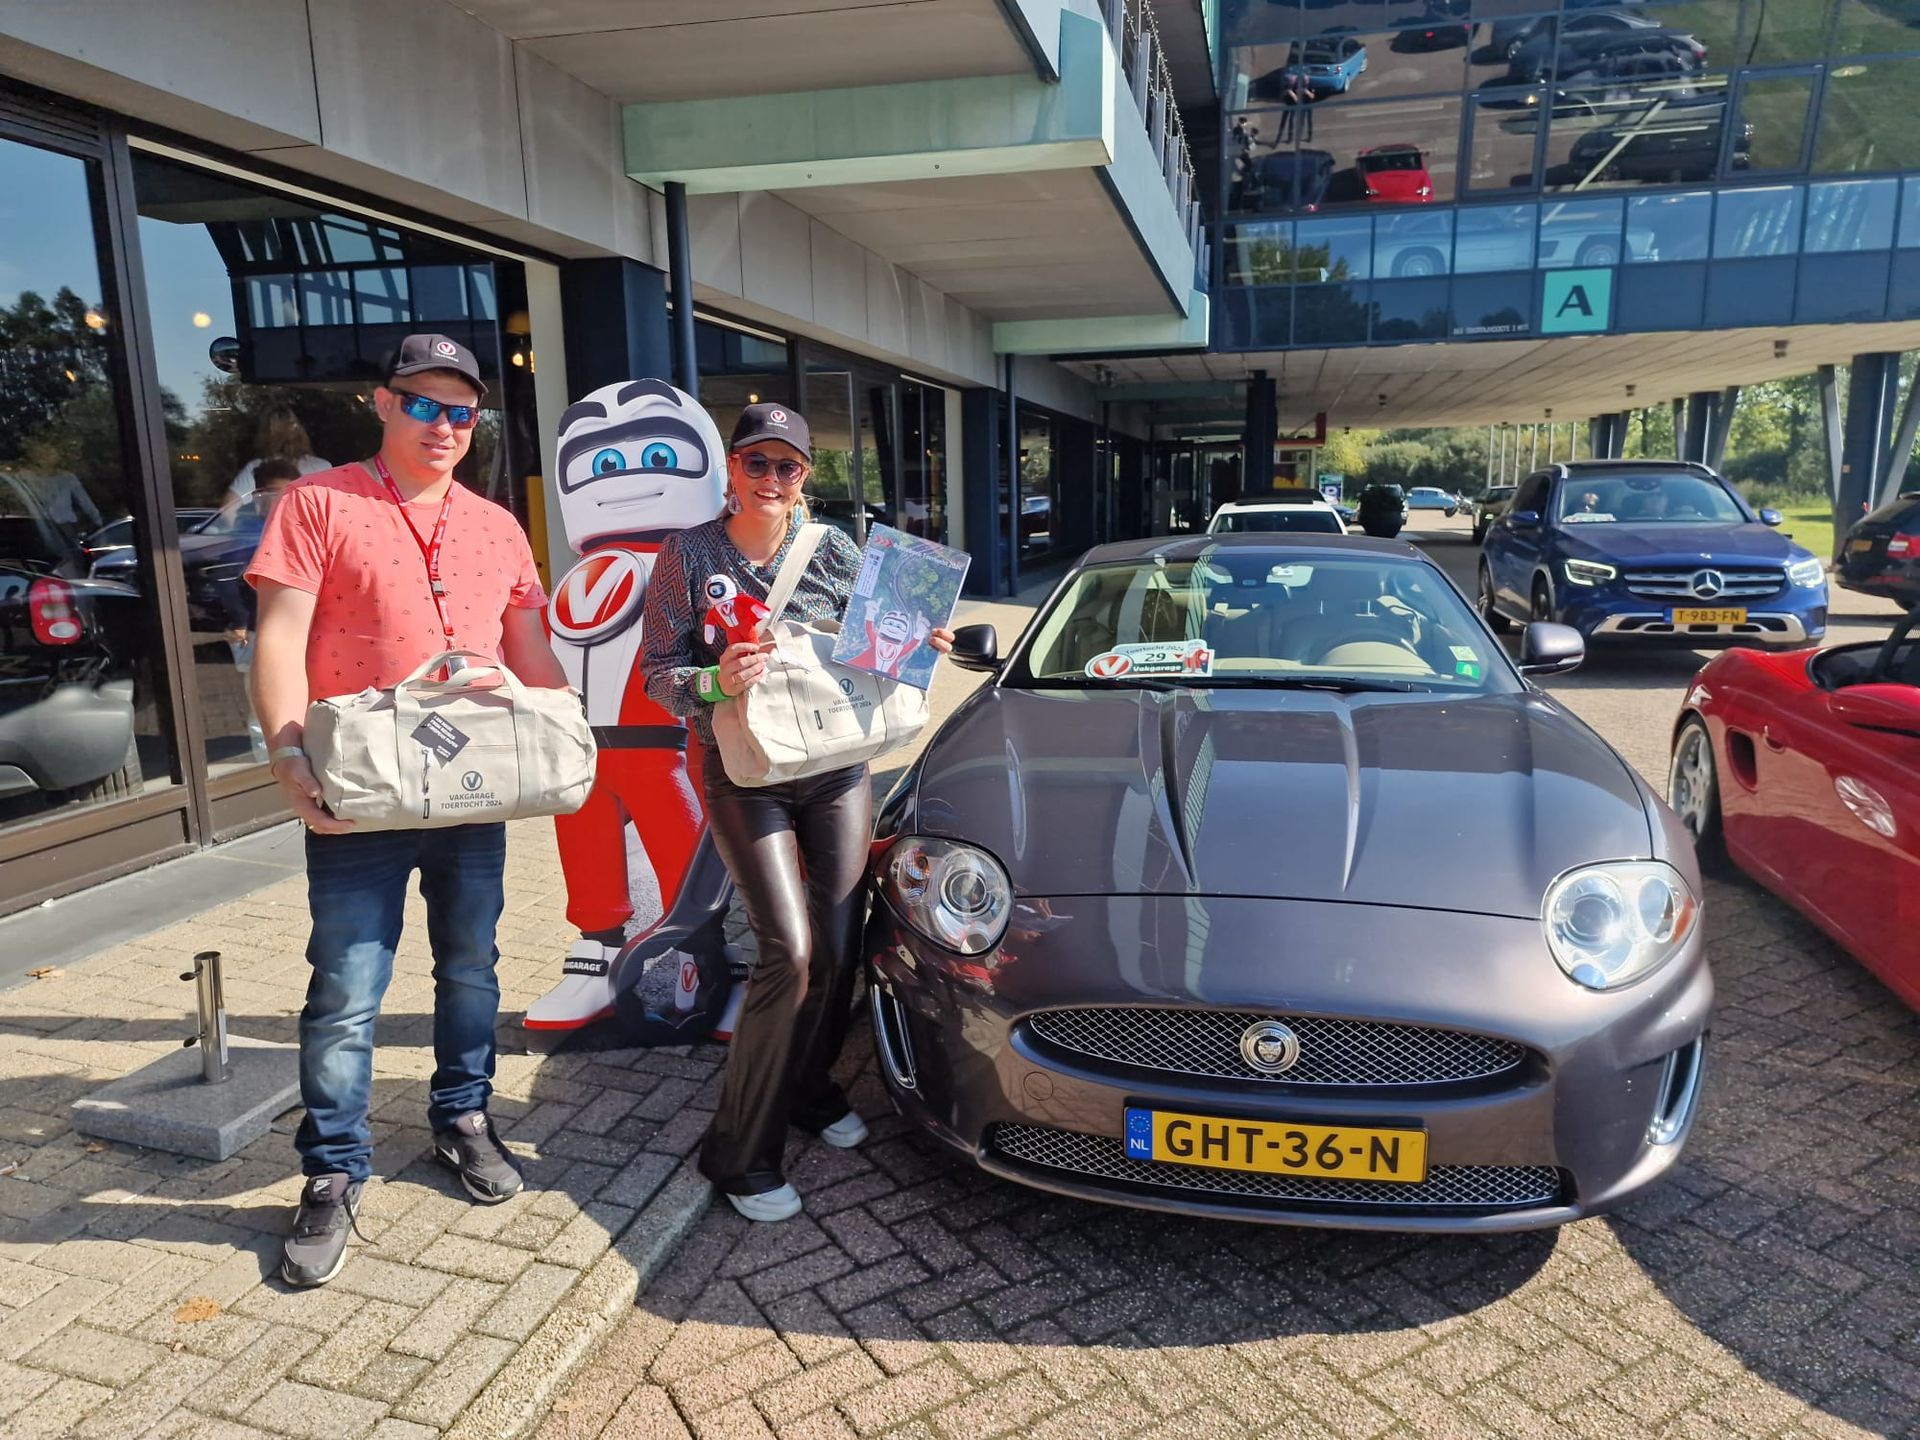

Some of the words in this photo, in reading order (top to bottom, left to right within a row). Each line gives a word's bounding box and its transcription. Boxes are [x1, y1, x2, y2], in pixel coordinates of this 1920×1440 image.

[1555, 284, 1593, 318] A
[568, 555, 635, 624] V
[1676, 610, 1740, 622] T-983-FN
[1145, 653, 1166, 662] 29
[1133, 664, 1182, 673] Vakgarage
[449, 792, 496, 801] VAKGARAGE
[441, 801, 484, 809] TOERTOCHT
[1131, 1138, 1149, 1151] NL
[1165, 1120, 1400, 1174] GHT-36-N
